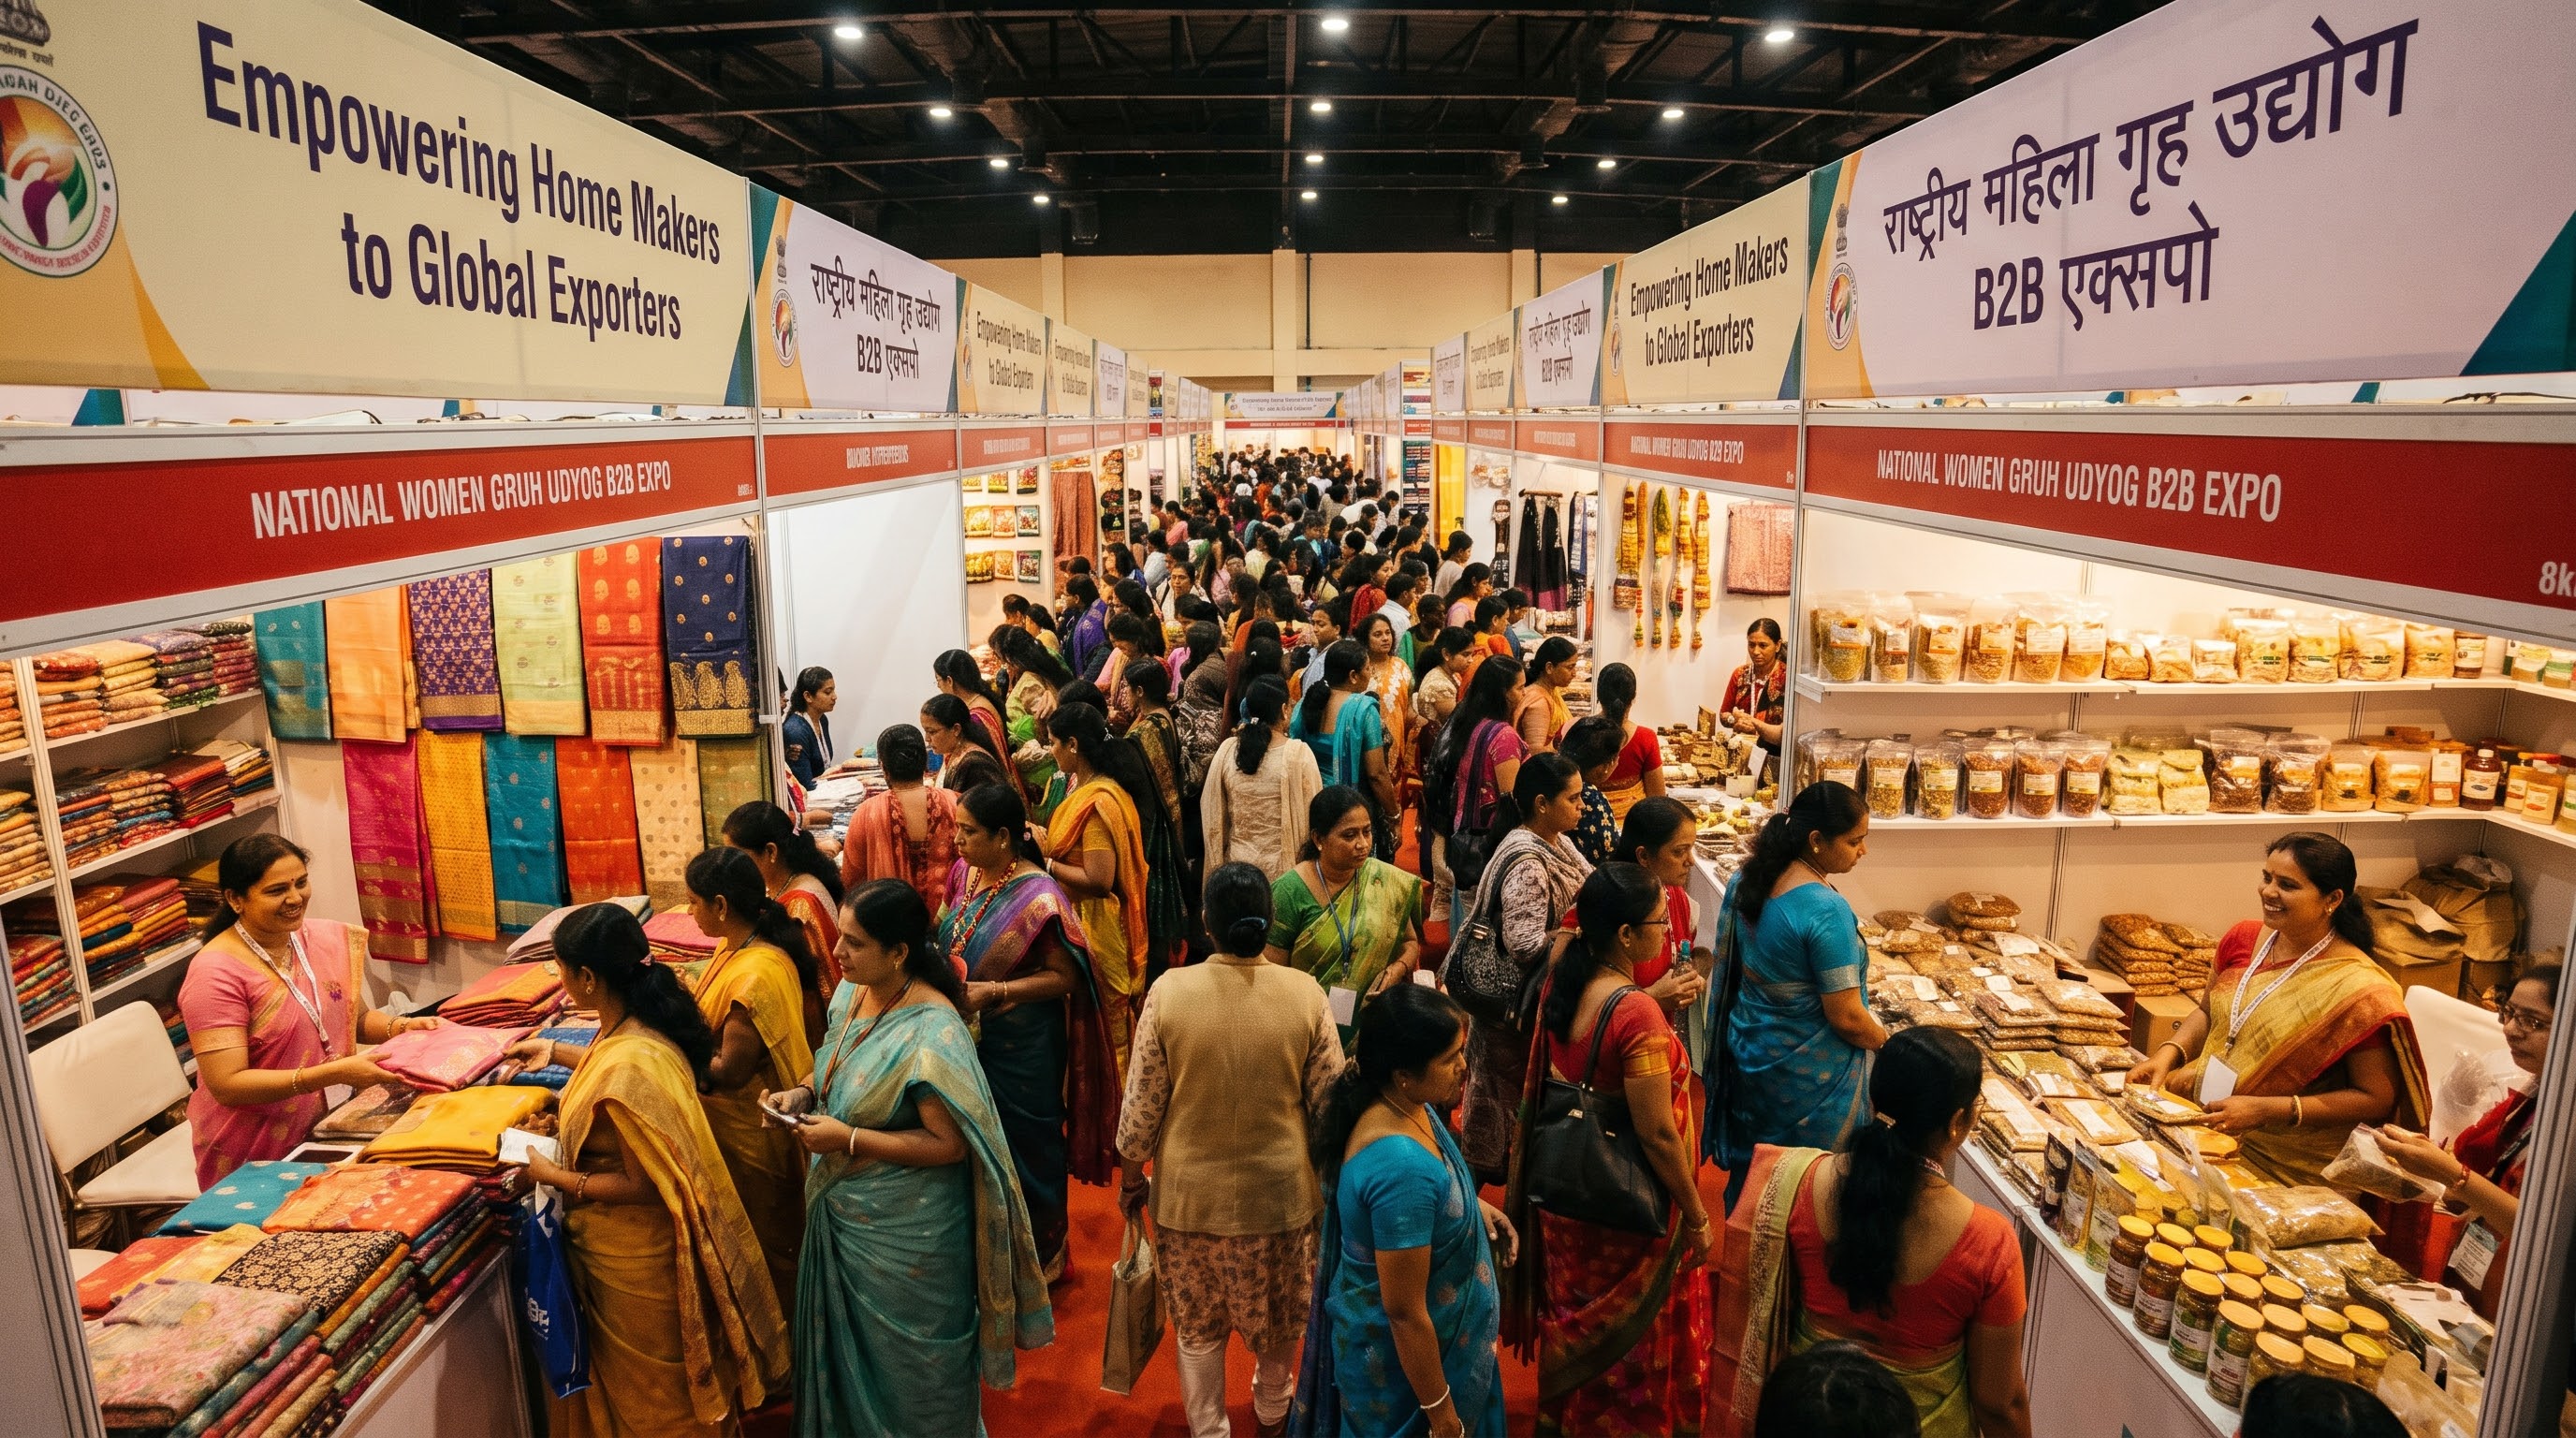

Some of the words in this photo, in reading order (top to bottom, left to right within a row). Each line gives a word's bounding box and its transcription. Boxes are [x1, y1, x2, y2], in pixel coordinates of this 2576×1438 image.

[197, 20, 520, 224] Empowering
[530, 142, 622, 237] Home
[631, 180, 720, 265] Makers
[1883, 167, 1971, 261] राष्ट्रीय
[1983, 133, 2100, 226] महिला
[2115, 99, 2194, 216] गृह
[2212, 15, 2420, 158] उद्योग
[341, 212, 392, 300] to
[408, 223, 537, 319] Global
[548, 255, 681, 343] Exporters
[811, 255, 856, 319] राष्ट्रीय
[858, 269, 894, 321] महिला
[897, 291, 913, 334] गृह
[915, 289, 941, 333] उद्योग
[1631, 266, 1691, 322] Empowering
[1695, 257, 1731, 299] Home
[1734, 235, 1789, 287] Makers
[1974, 257, 2044, 330] B2B
[2059, 200, 2219, 331] एक्सपो
[857, 333, 882, 374] B2B
[885, 337, 919, 382] एक्सपो
[1646, 331, 1654, 367] to
[1657, 320, 1690, 365] Global
[1693, 313, 1754, 368] Exporters
[1723, 440, 1744, 464] EXPO
[1877, 449, 1939, 485] NATIONAL
[1944, 453, 2005, 492] WOMEN
[2008, 457, 2060, 498] GRUH
[2065, 462, 2140, 506] UDYOG
[2145, 466, 2196, 512] B2B
[2203, 470, 2282, 522] EXPO
[251, 483, 394, 539] NATIONAL
[397, 475, 486, 521] WOMEN
[490, 471, 543, 511] GRUH
[547, 465, 604, 505] UDYOG
[605, 463, 635, 497] B2B
[637, 460, 671, 493] EXPO
[2539, 561, 2576, 597] 8k
